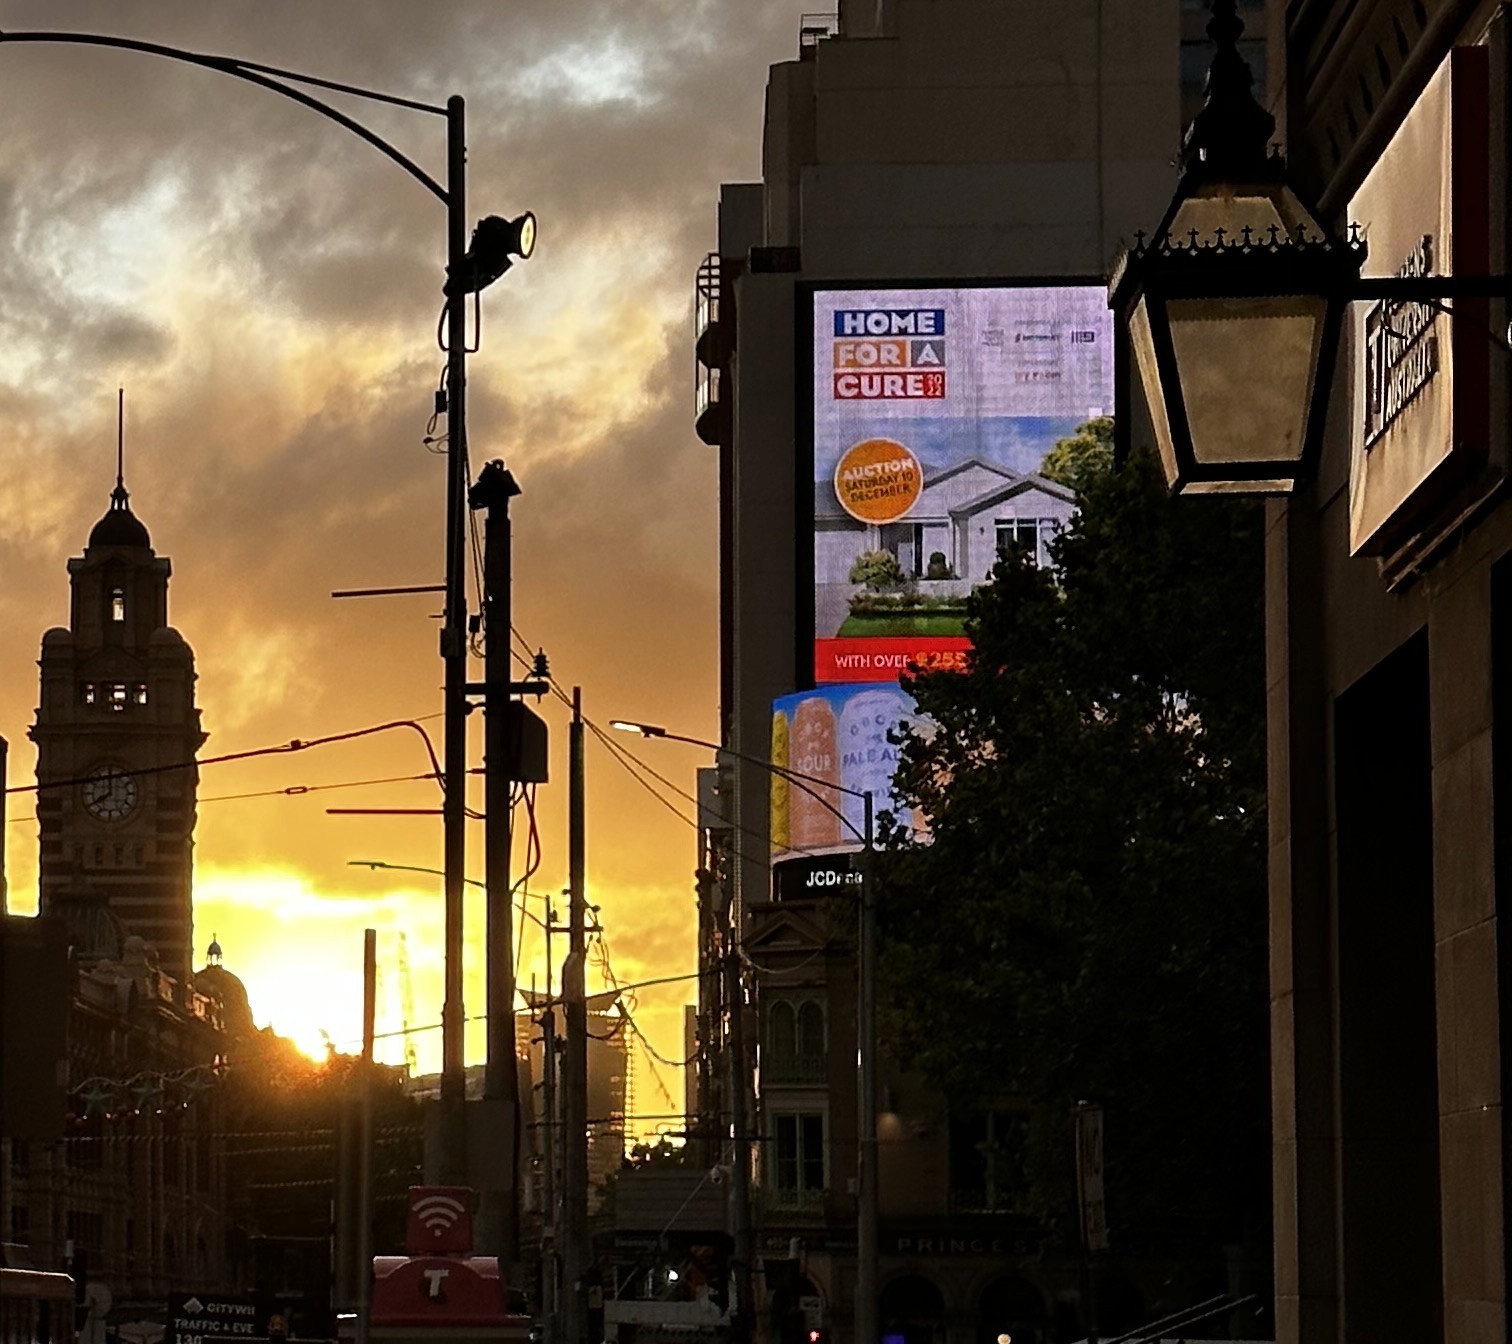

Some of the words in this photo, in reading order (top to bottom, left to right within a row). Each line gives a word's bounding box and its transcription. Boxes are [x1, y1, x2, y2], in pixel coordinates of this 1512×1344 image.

[843, 311, 937, 335] HOME
[837, 342, 901, 366] FOR
[915, 343, 940, 366] A
[836, 373, 924, 397] CURE
[843, 458, 914, 480] AUCTION
[845, 473, 899, 493] SATURDAY
[901, 471, 914, 482] 10
[850, 483, 912, 503] DECEMBER
[834, 653, 870, 668] WITH
[173, 1318, 221, 1332] TRAFFIC
[232, 1322, 255, 1334] EVE
